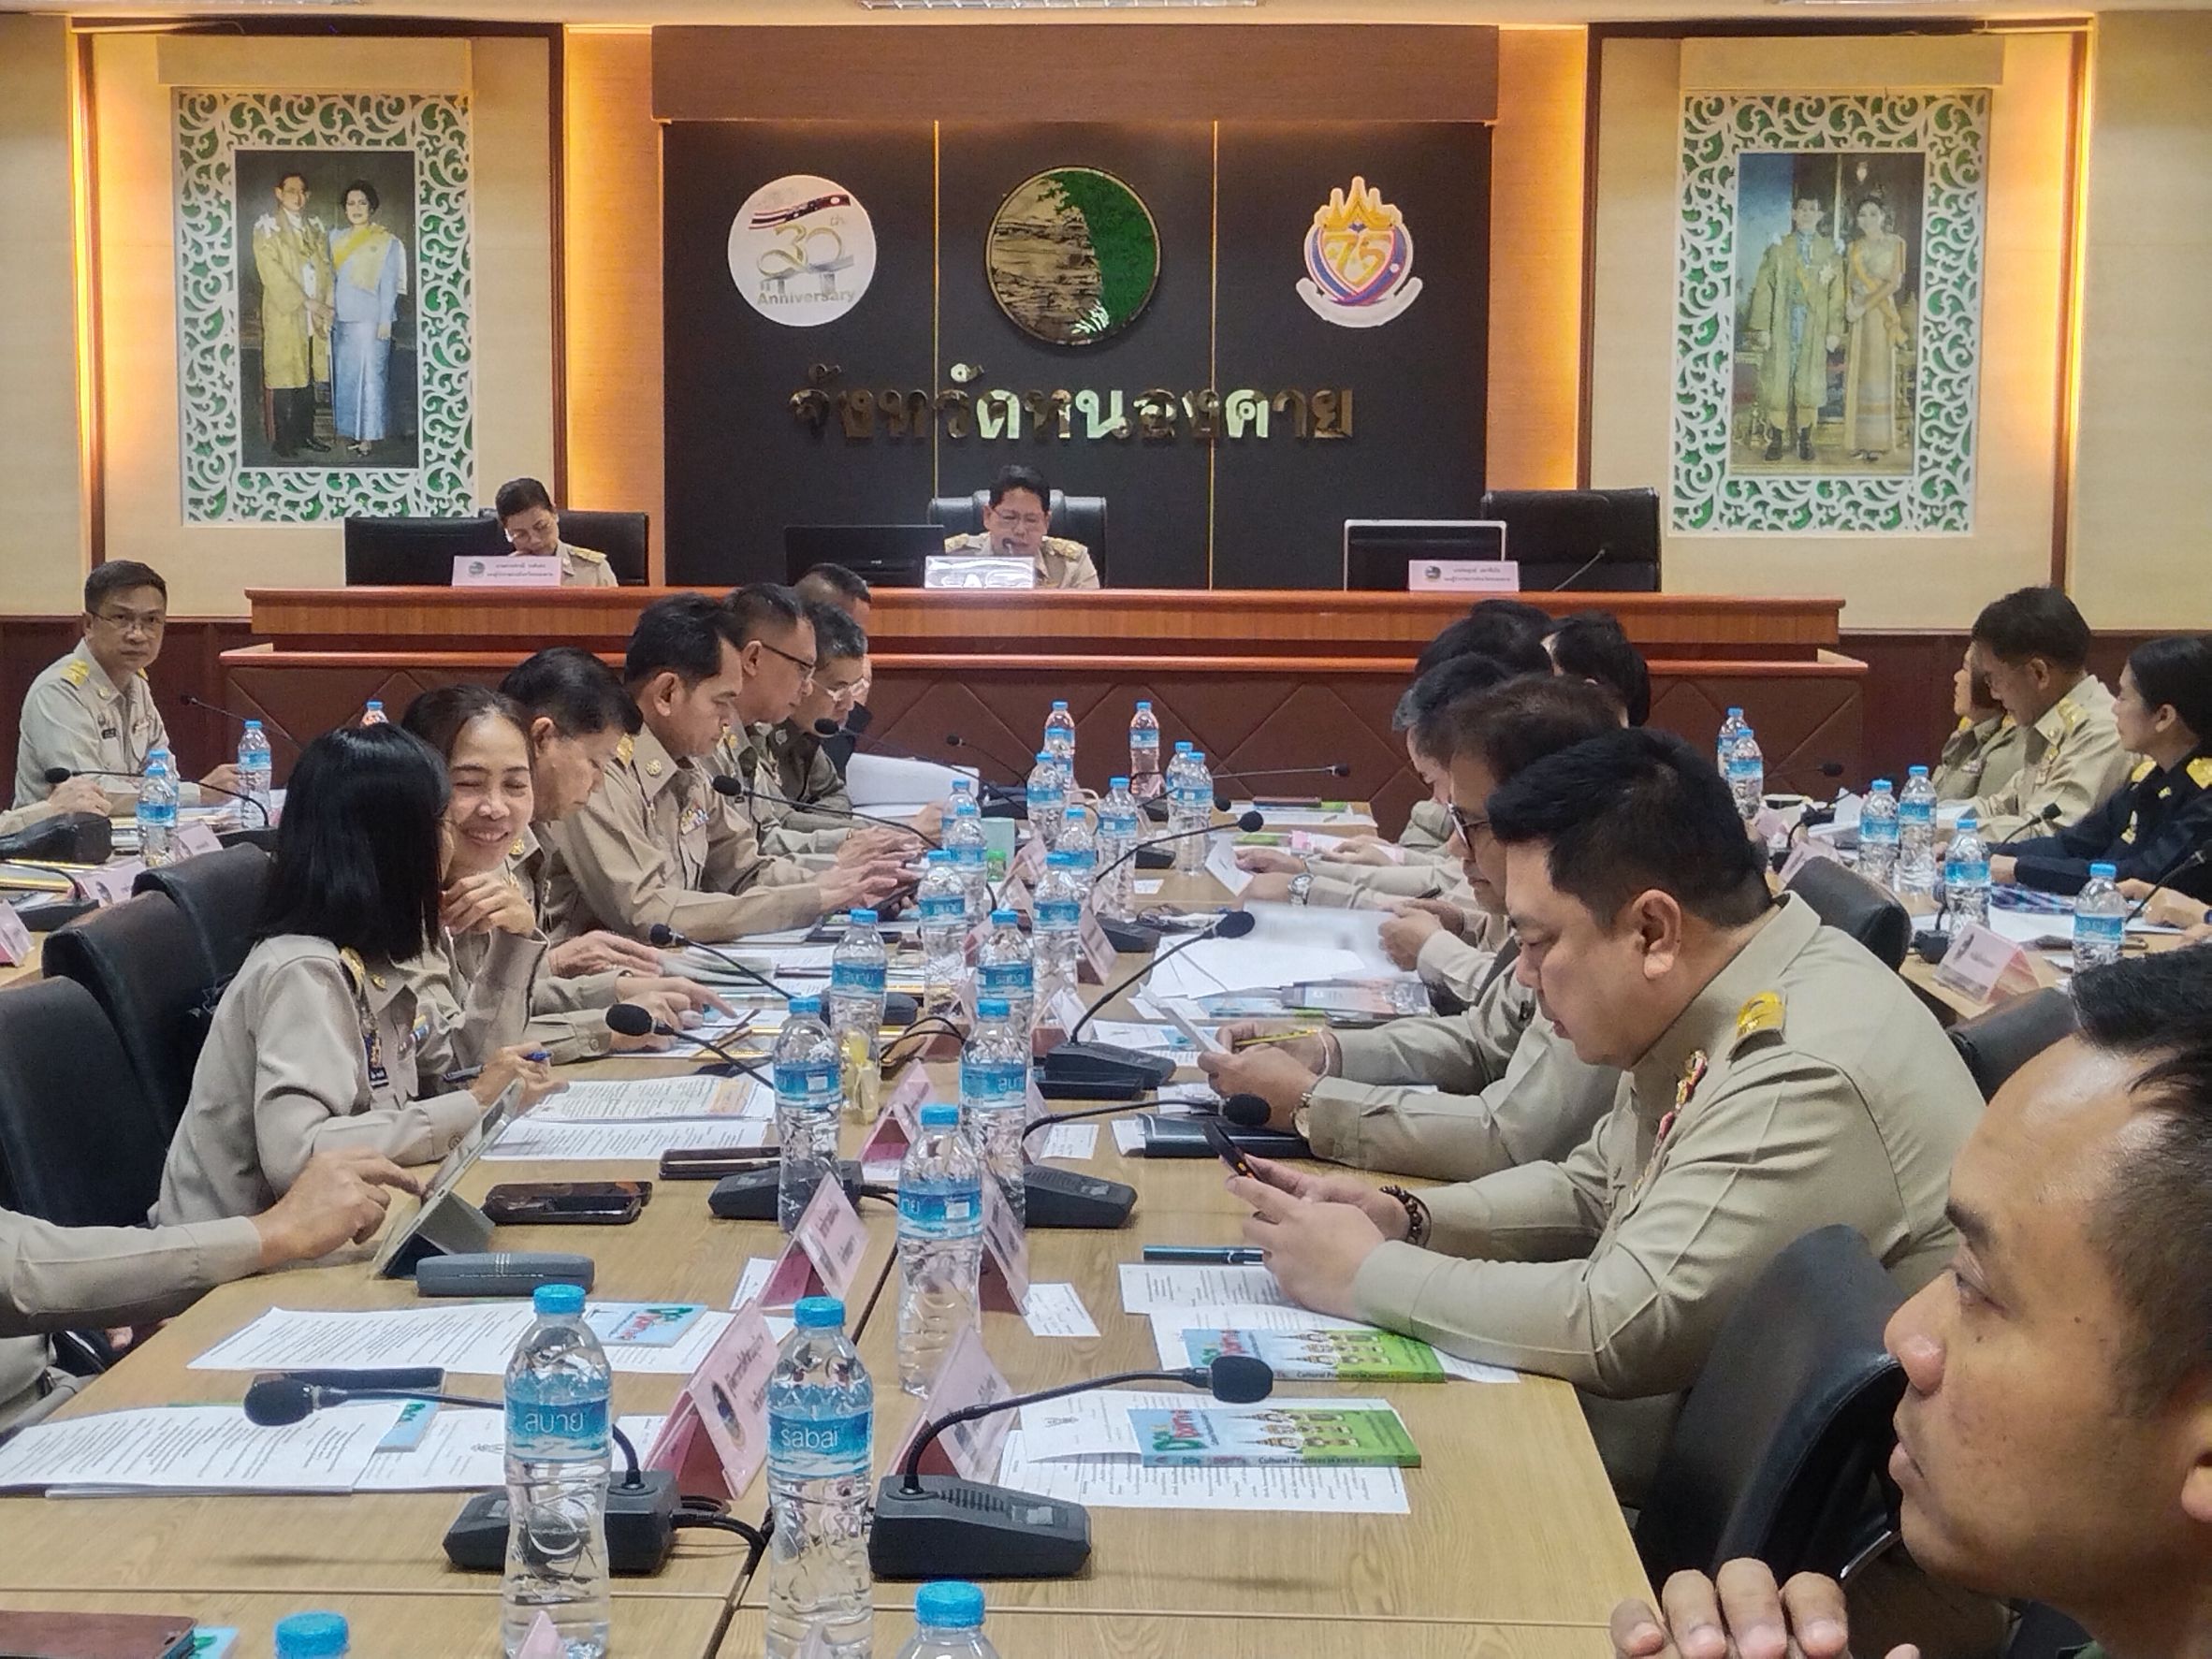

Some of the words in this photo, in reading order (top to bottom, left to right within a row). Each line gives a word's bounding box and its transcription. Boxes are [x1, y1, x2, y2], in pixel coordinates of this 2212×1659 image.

[757, 288, 856, 306] Anniversary
[790, 362, 1353, 439] จังหวัดหนองคาย
[525, 1411, 584, 1433] สบาย
[1258, 1456, 1289, 1465] Cultural
